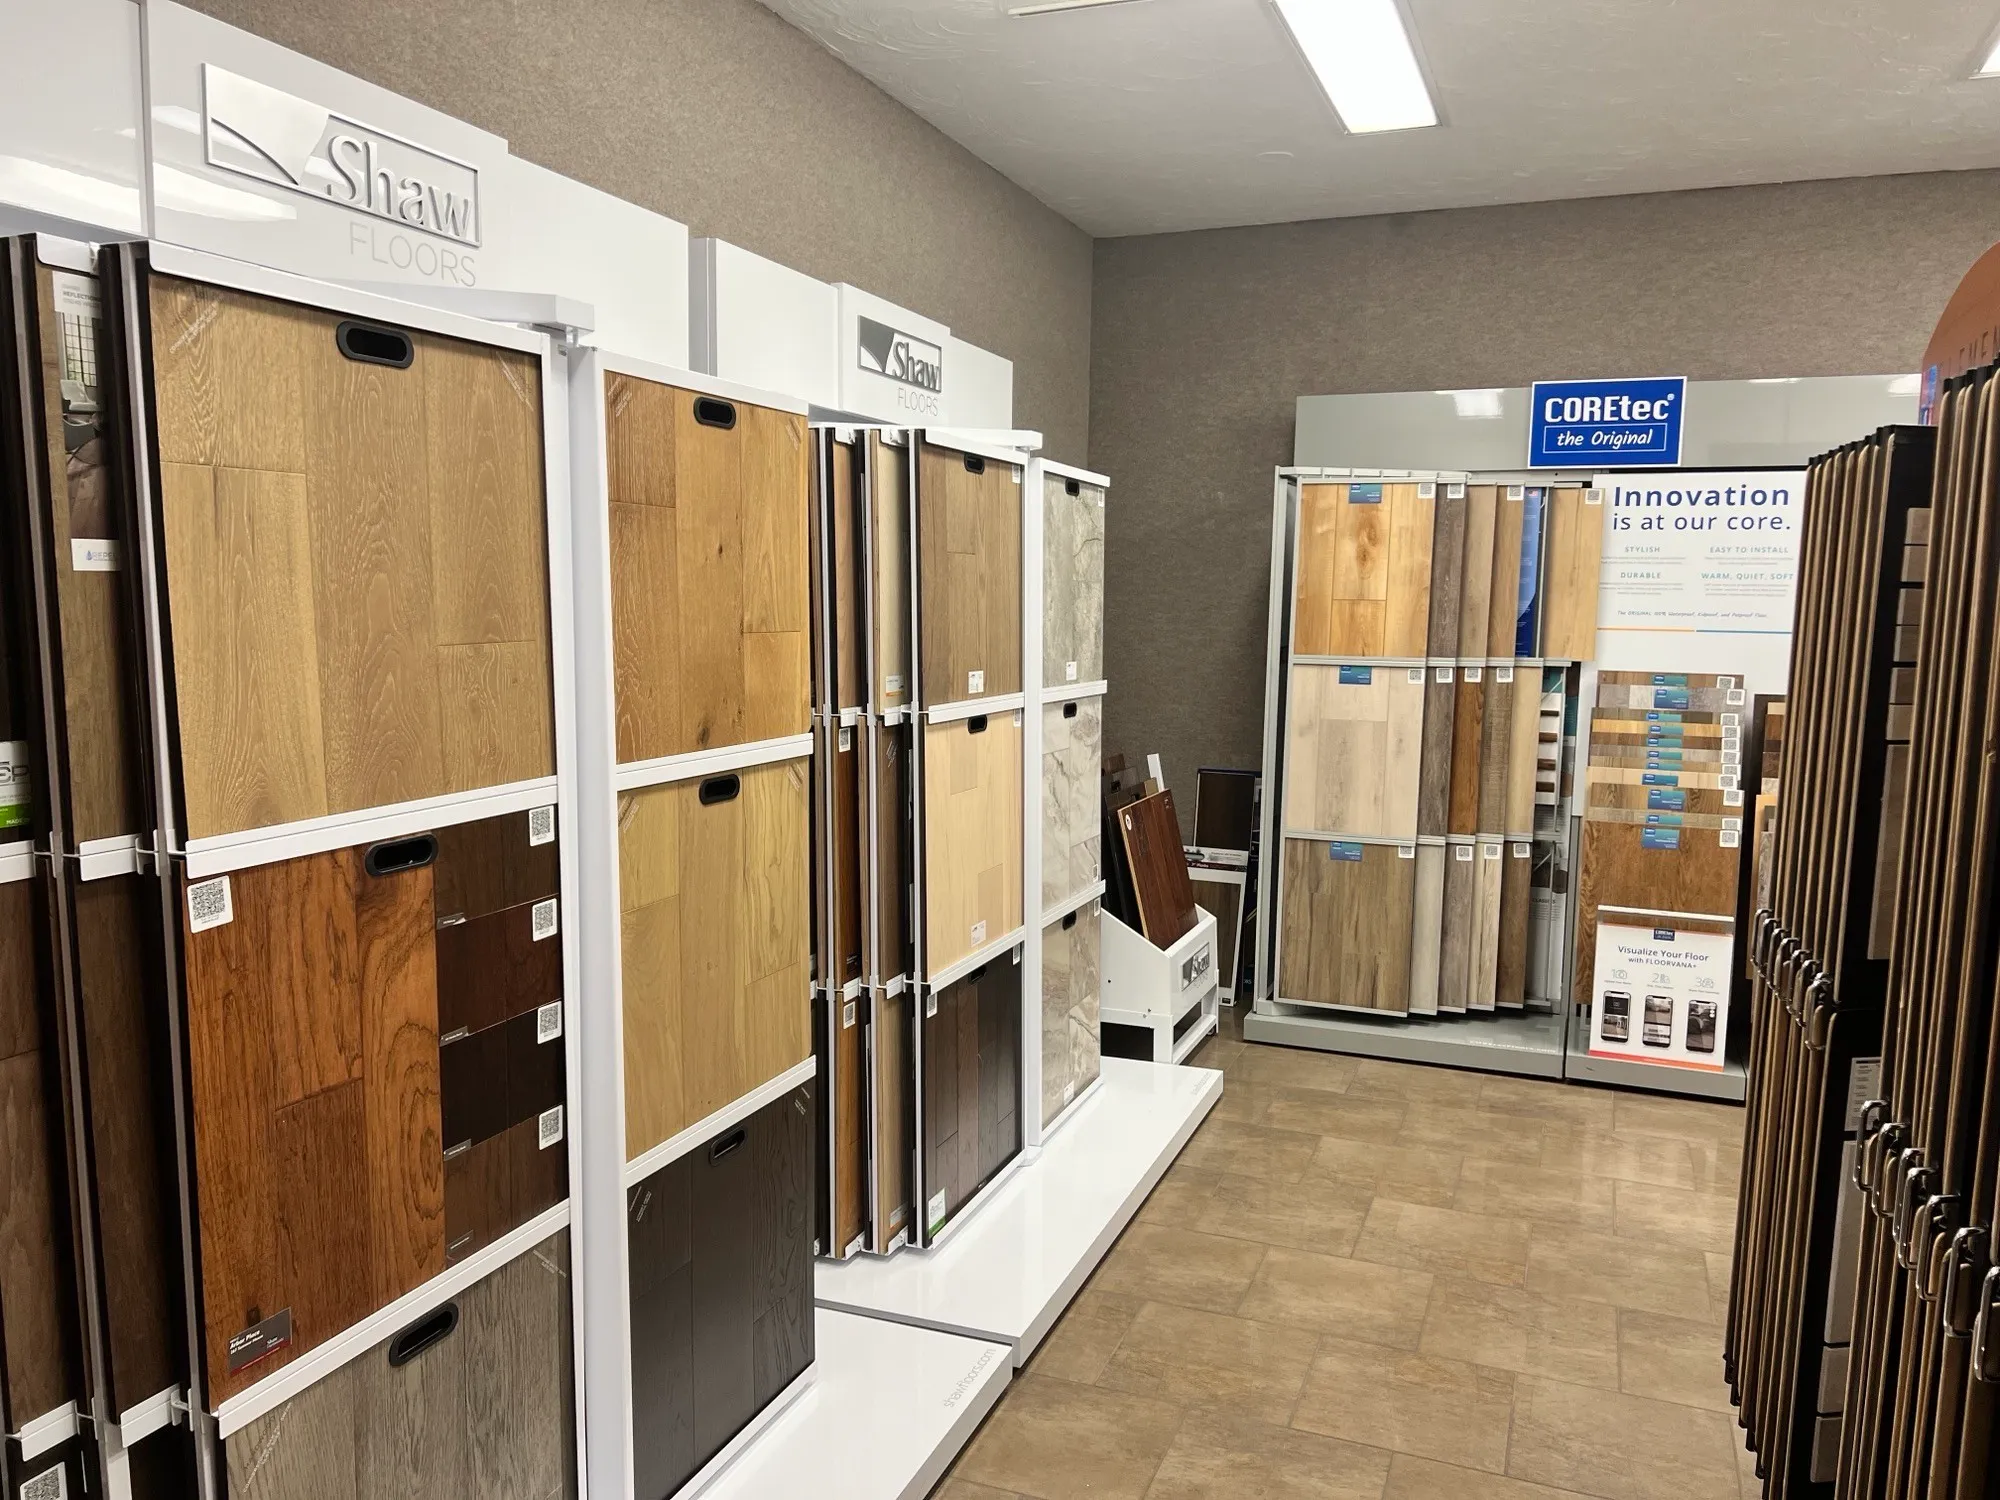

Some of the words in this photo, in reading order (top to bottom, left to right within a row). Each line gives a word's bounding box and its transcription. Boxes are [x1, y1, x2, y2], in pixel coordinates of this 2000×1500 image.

[327, 135, 472, 238] Shaw
[350, 221, 476, 287] FLOORS
[892, 341, 940, 390] Shaw
[897, 387, 938, 416] FLOORS
[1558, 431, 1584, 446] the
[1591, 428, 1653, 449] Original
[1614, 484, 1789, 506] Innovation
[1613, 513, 1631, 530] is
[1641, 514, 1664, 530] at
[1674, 516, 1717, 530] our
[1727, 516, 1790, 530] core.
[1618, 945, 1658, 956] Visualize
[1660, 950, 1682, 959] Your
[1685, 952, 1709, 961] Floor
[943, 1348, 997, 1408] shawfloors.com
